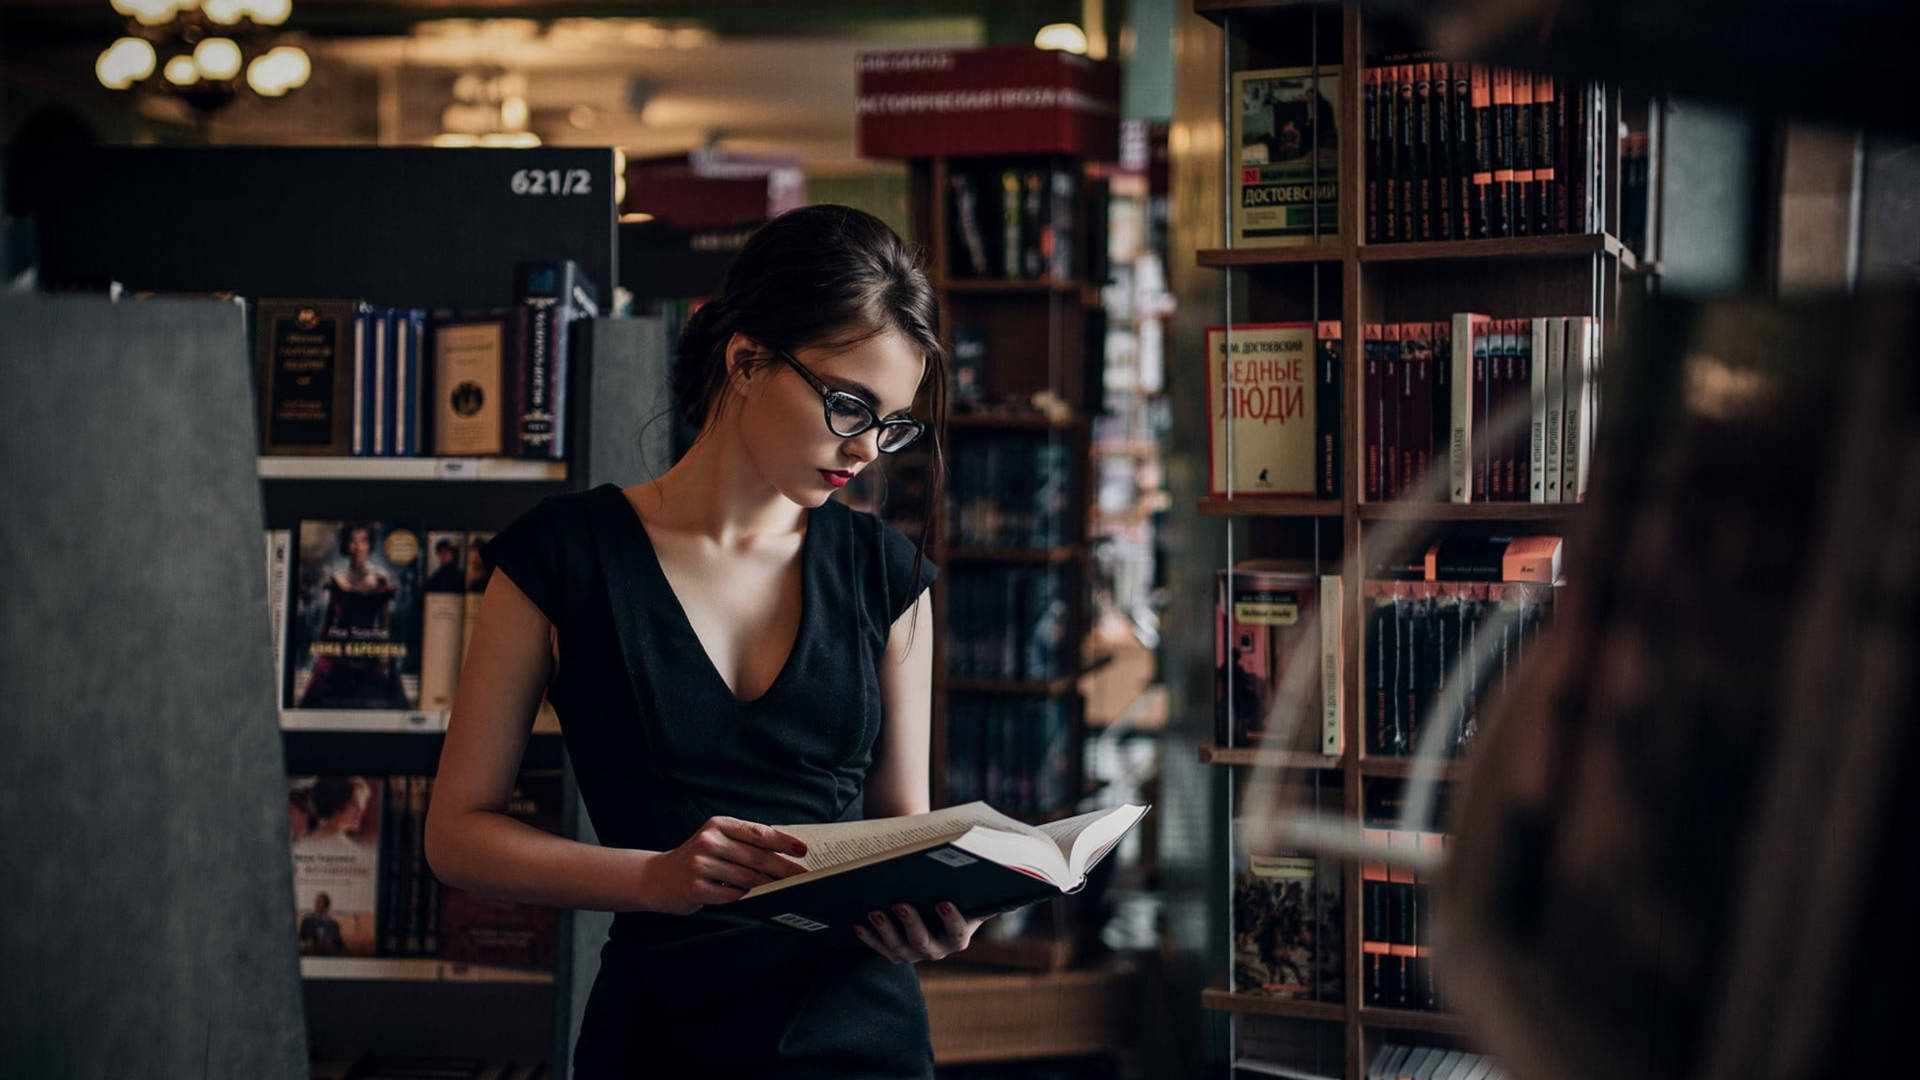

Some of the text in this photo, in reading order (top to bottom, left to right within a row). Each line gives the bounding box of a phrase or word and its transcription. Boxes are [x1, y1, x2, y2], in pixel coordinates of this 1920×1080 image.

[994, 87, 1056, 110] ПРОЗА
[511, 168, 591, 196] 621/2
[1242, 340, 1303, 354] ДОСТОЕВСКИЙ
[1219, 385, 1304, 425] ЛЮДИ
